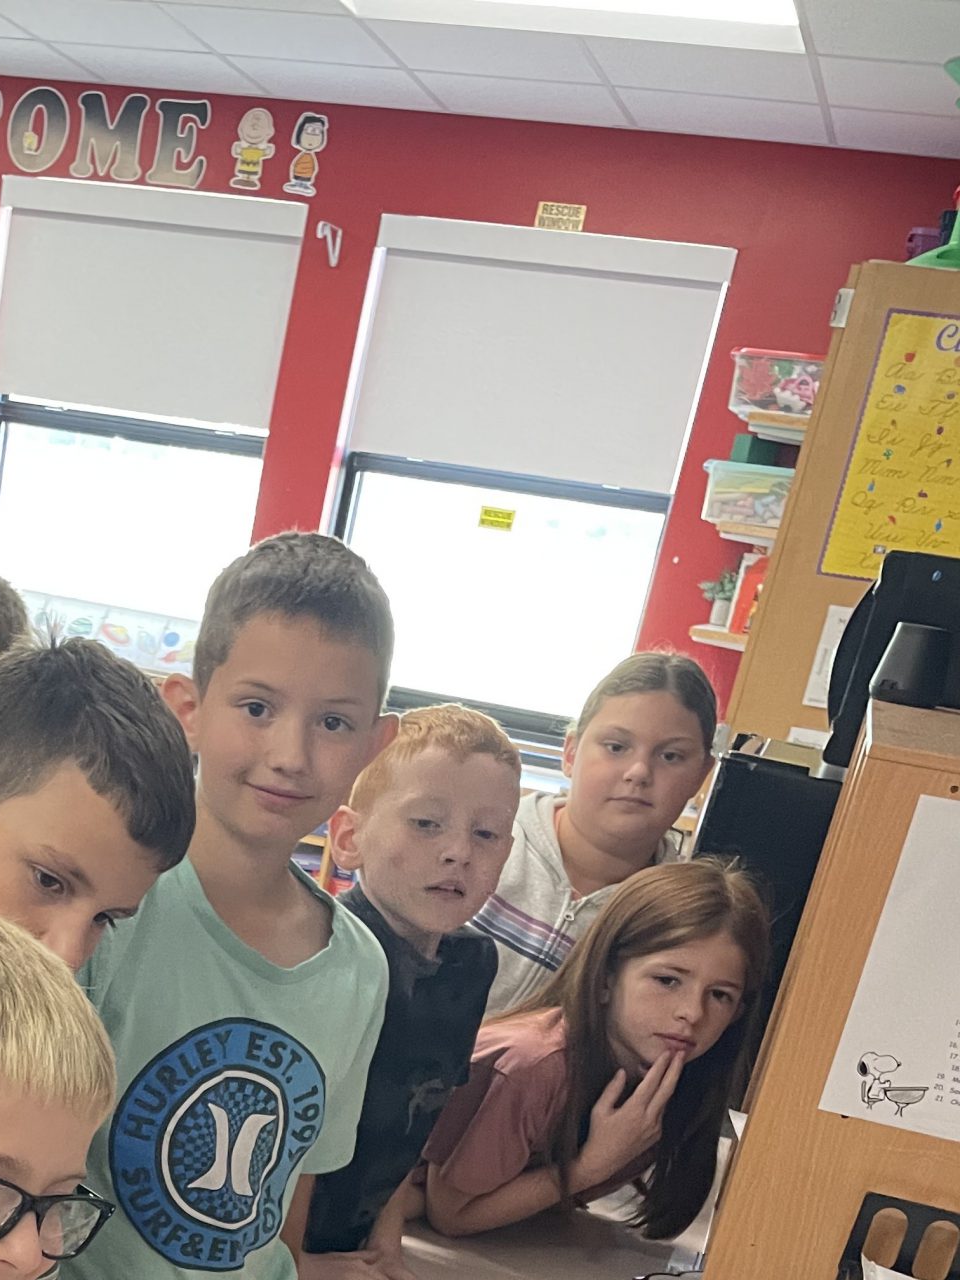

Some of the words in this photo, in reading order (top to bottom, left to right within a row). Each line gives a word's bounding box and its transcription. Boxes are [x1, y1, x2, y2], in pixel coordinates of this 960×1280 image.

[542, 203, 582, 218] RESCUE
[538, 215, 581, 231] WINDOW
[126, 1029, 233, 1141] HURLEY
[245, 1031, 303, 1083] EST.
